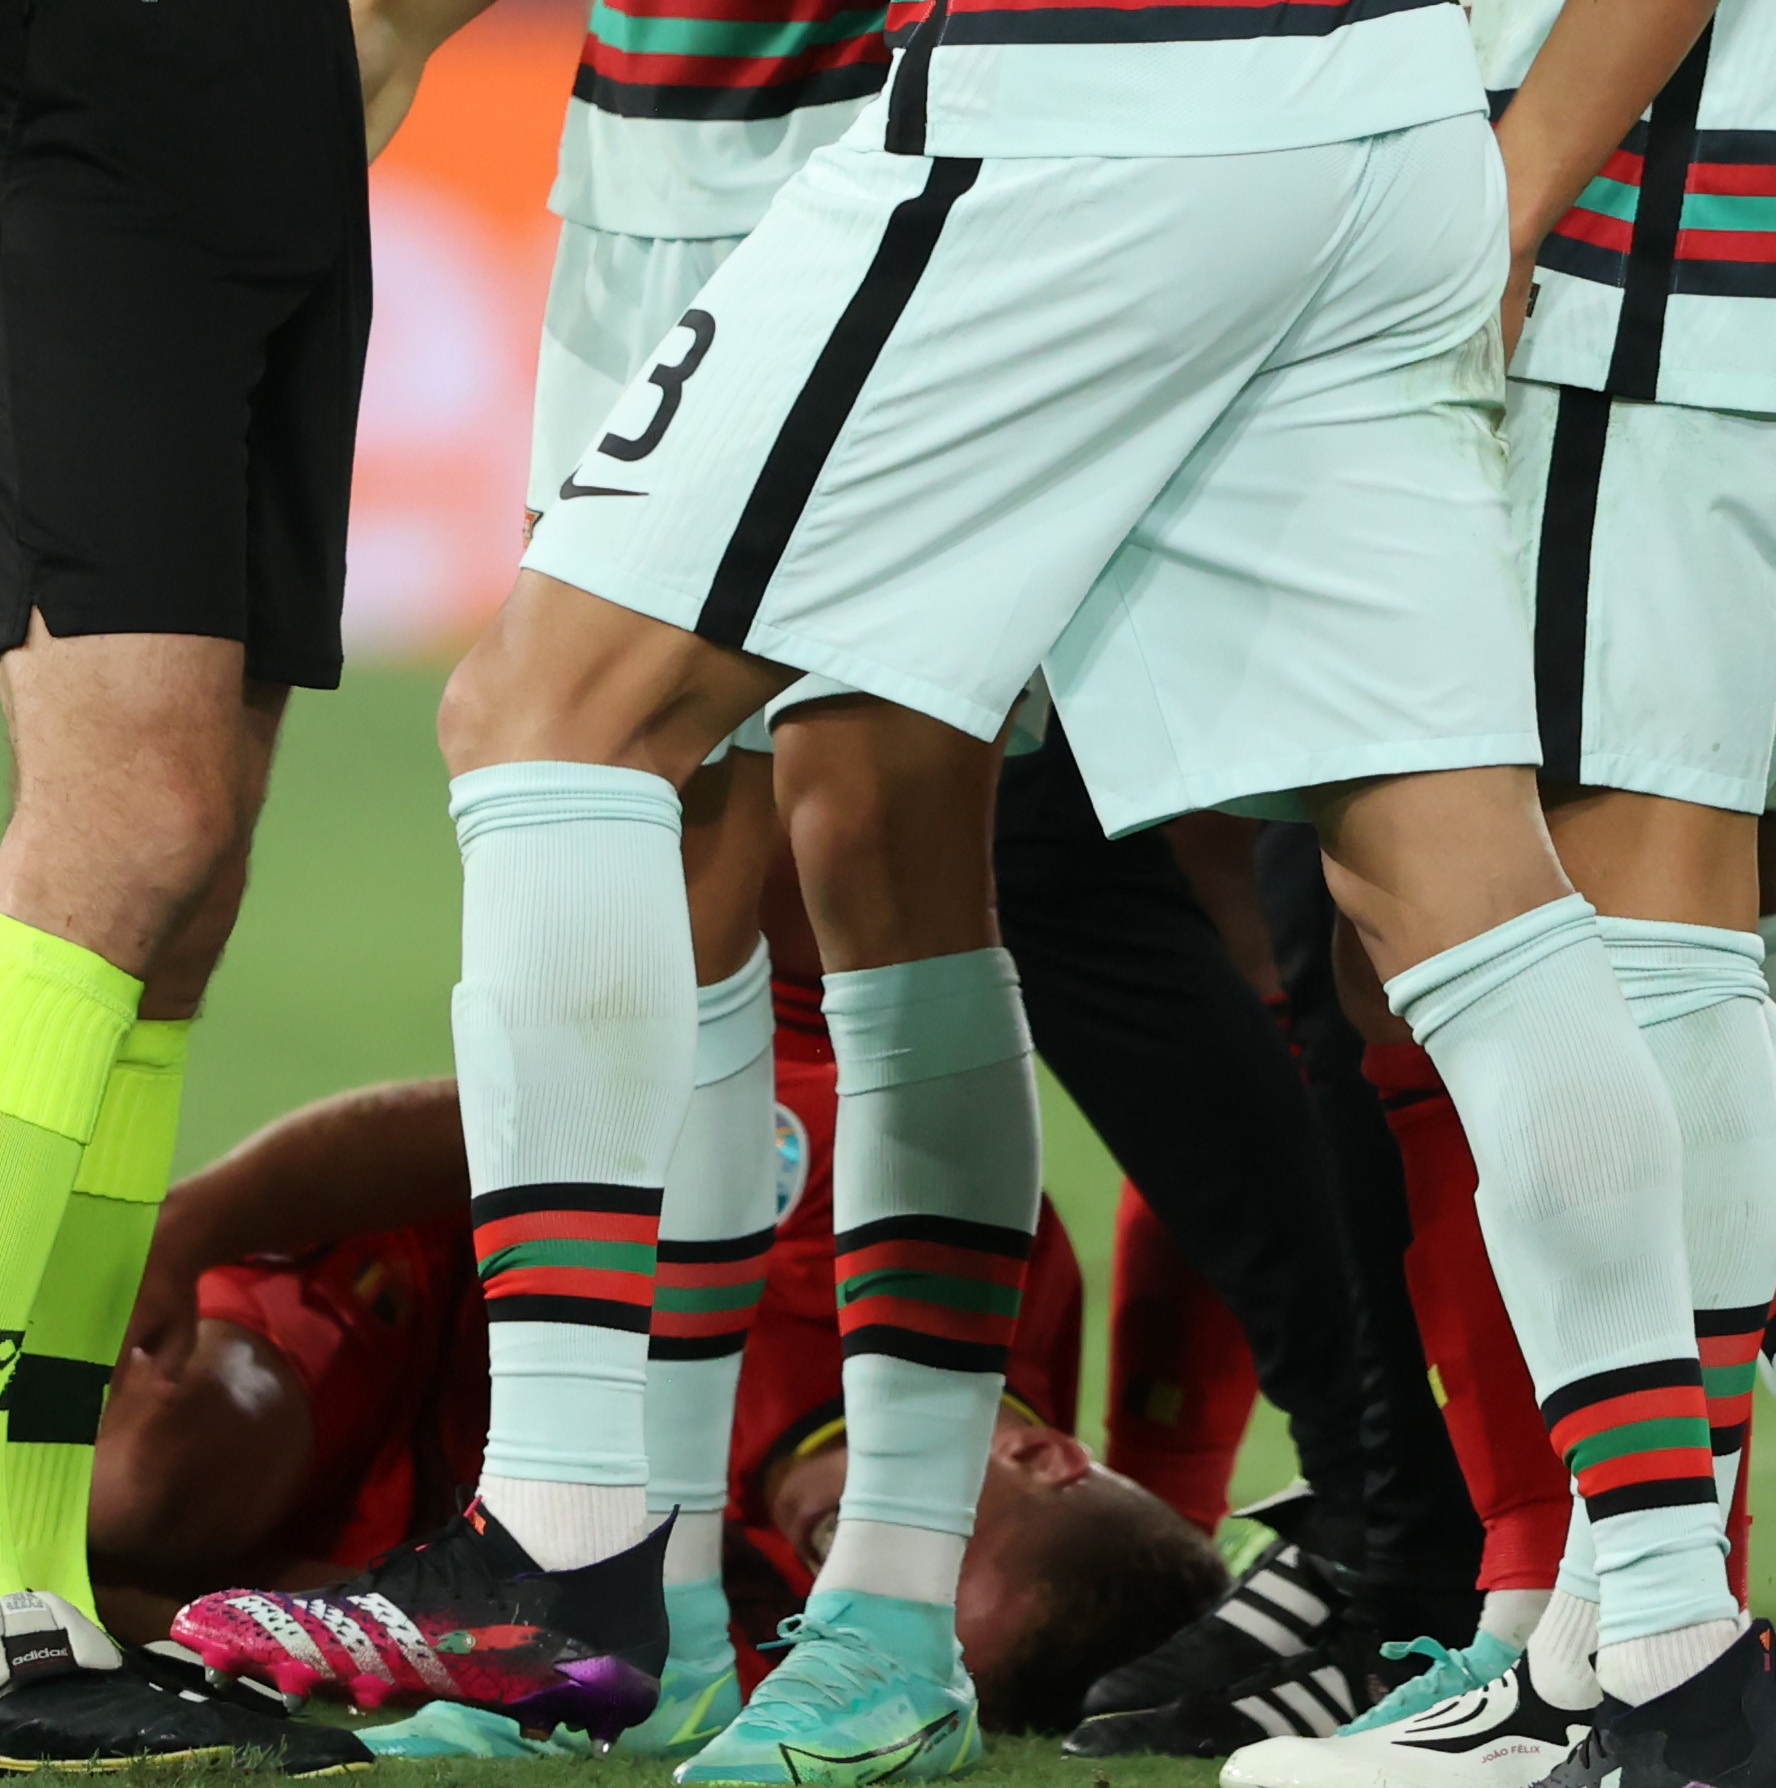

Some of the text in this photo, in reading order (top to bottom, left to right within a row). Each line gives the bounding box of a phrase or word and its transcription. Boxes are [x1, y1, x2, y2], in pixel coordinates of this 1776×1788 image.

[597, 308, 716, 462] 3
[1482, 1744, 1541, 1764] JOÃO FÉLIX
